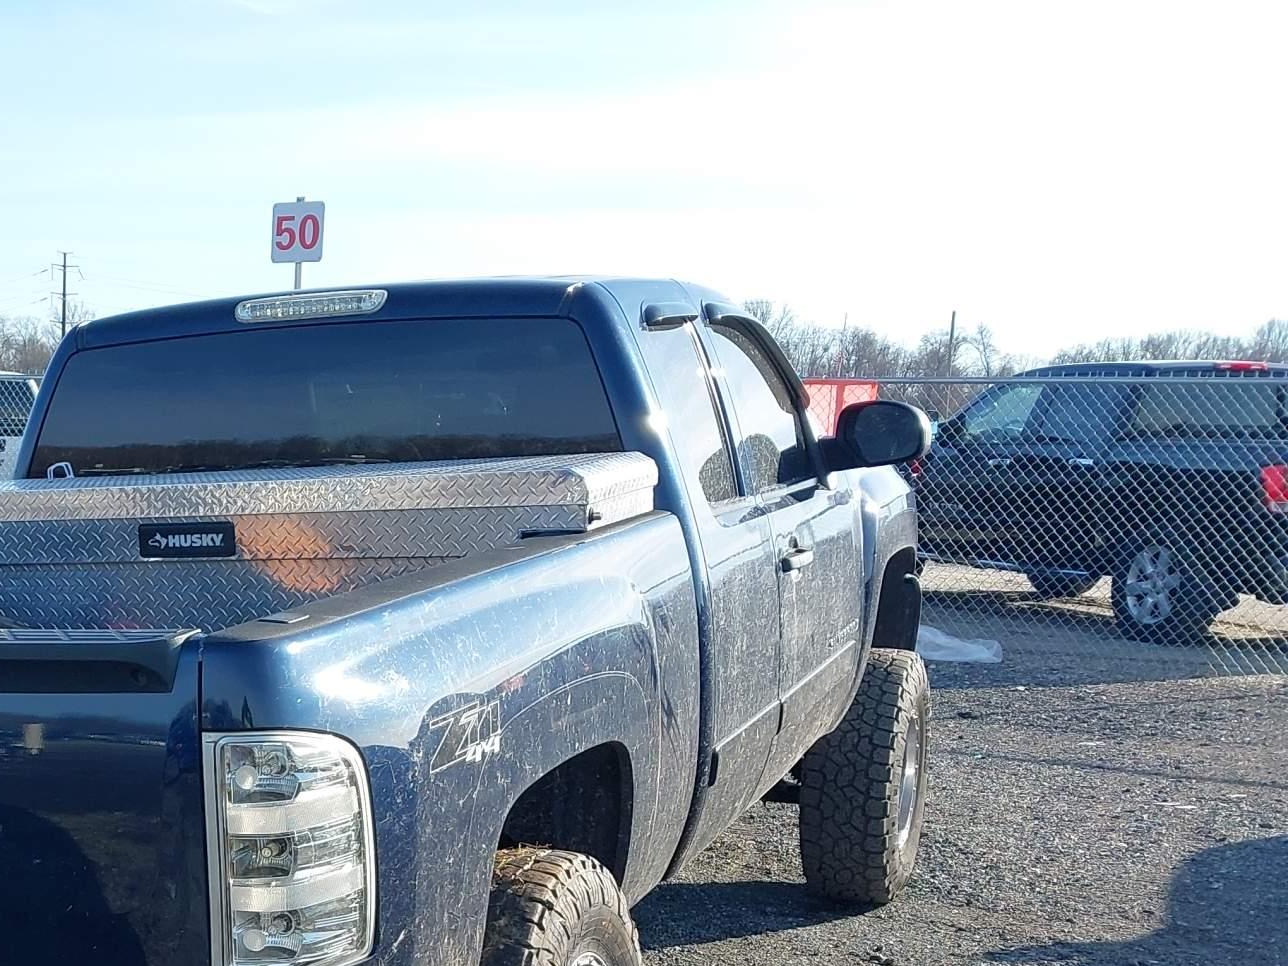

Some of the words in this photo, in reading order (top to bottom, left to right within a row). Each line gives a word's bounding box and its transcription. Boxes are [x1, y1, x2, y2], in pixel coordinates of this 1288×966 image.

[275, 214, 320, 251] 50
[167, 533, 224, 548] HUSKY
[429, 700, 502, 774] Z71
